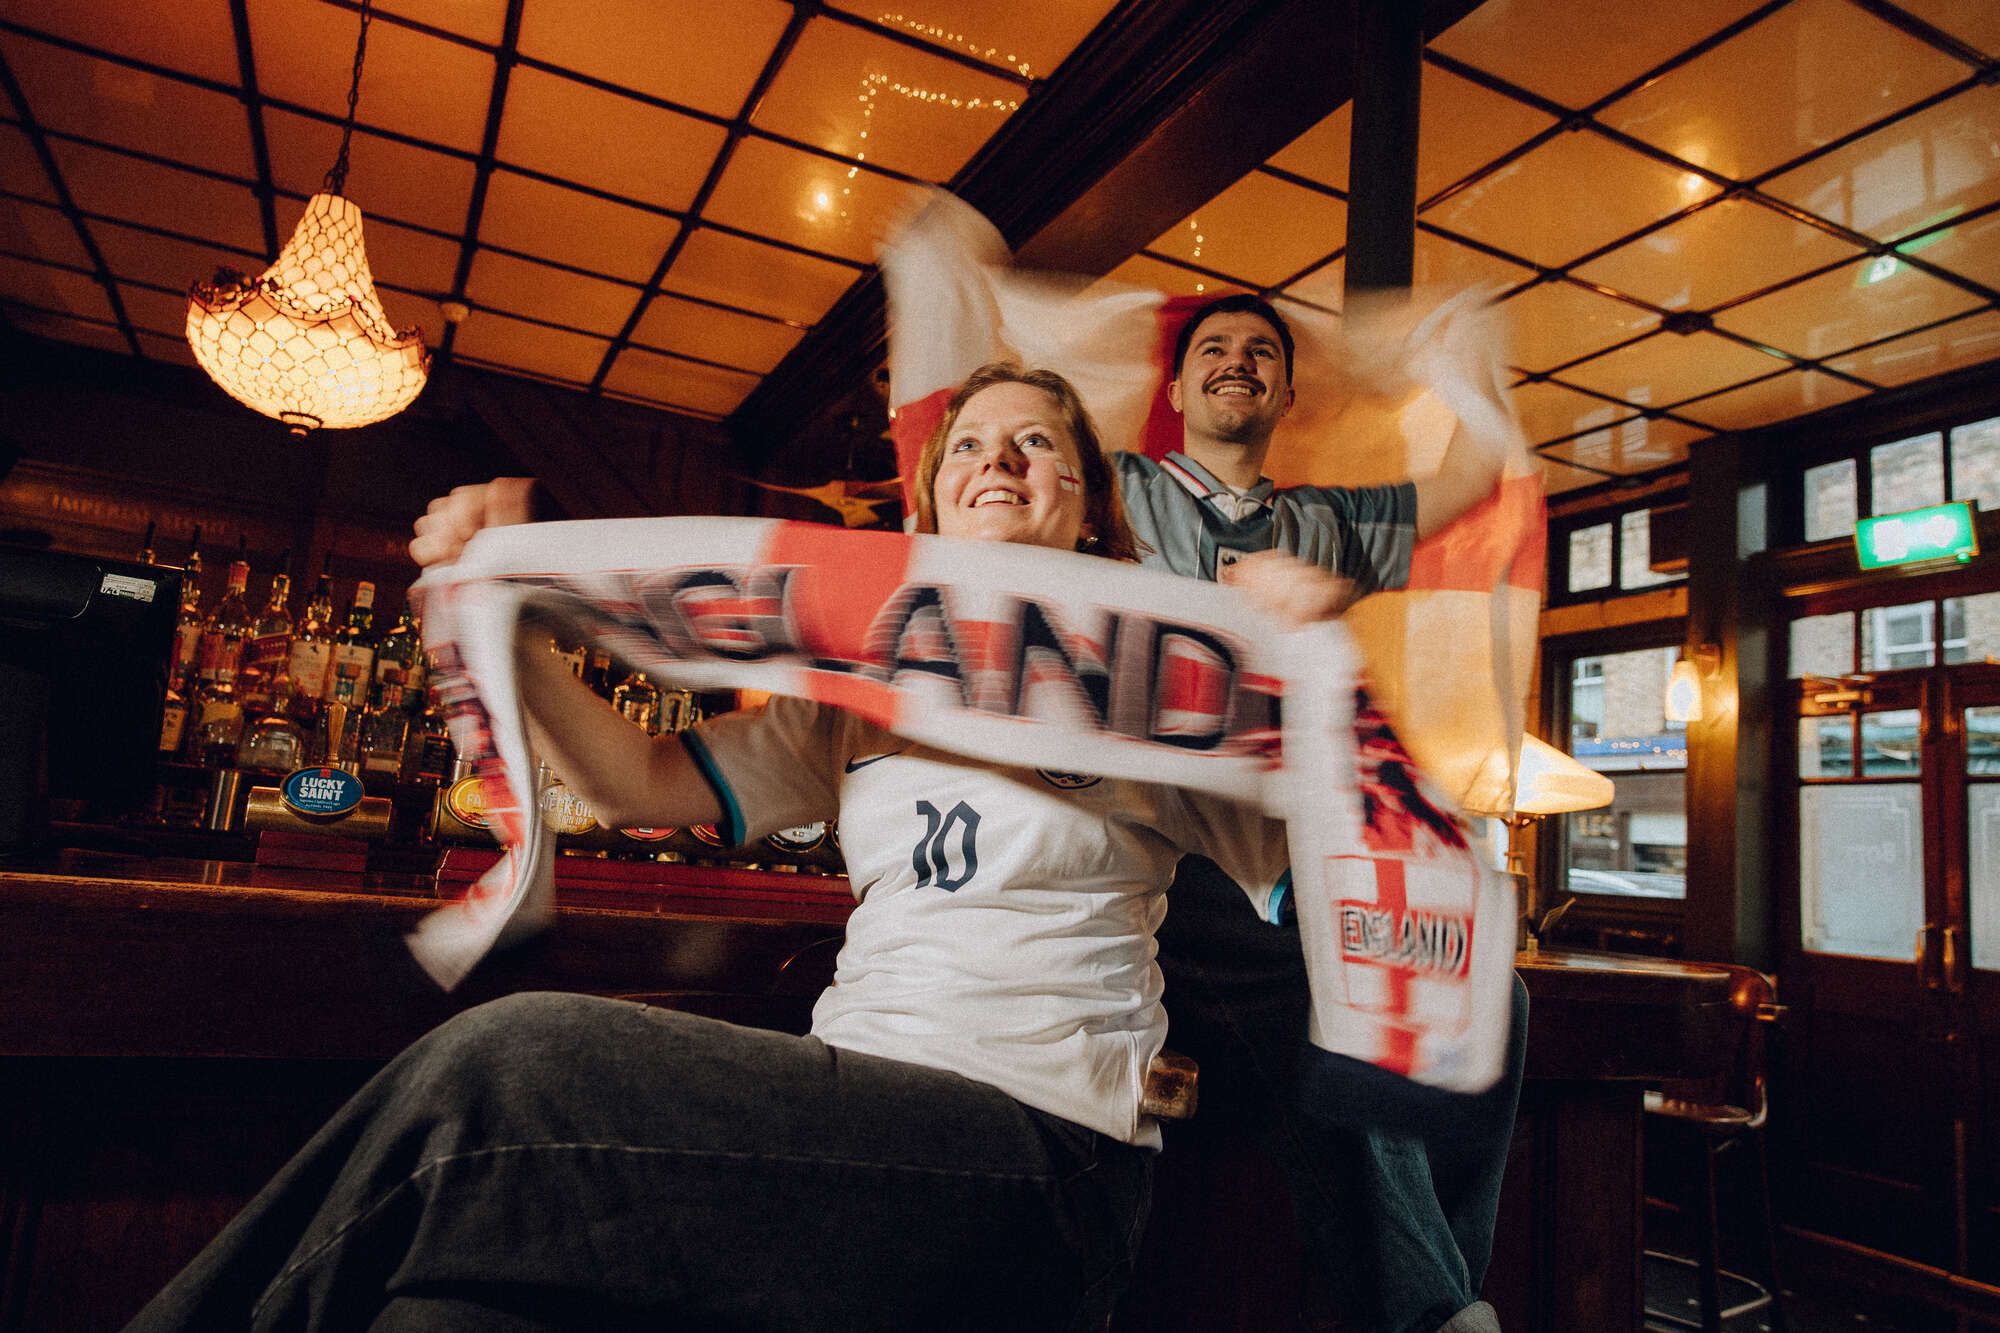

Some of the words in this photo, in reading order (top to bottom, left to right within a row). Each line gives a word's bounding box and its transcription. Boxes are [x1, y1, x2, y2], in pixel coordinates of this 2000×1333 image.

[301, 776, 346, 790] LUCKY
[299, 787, 343, 801] SAINT
[912, 800, 982, 893] 10
